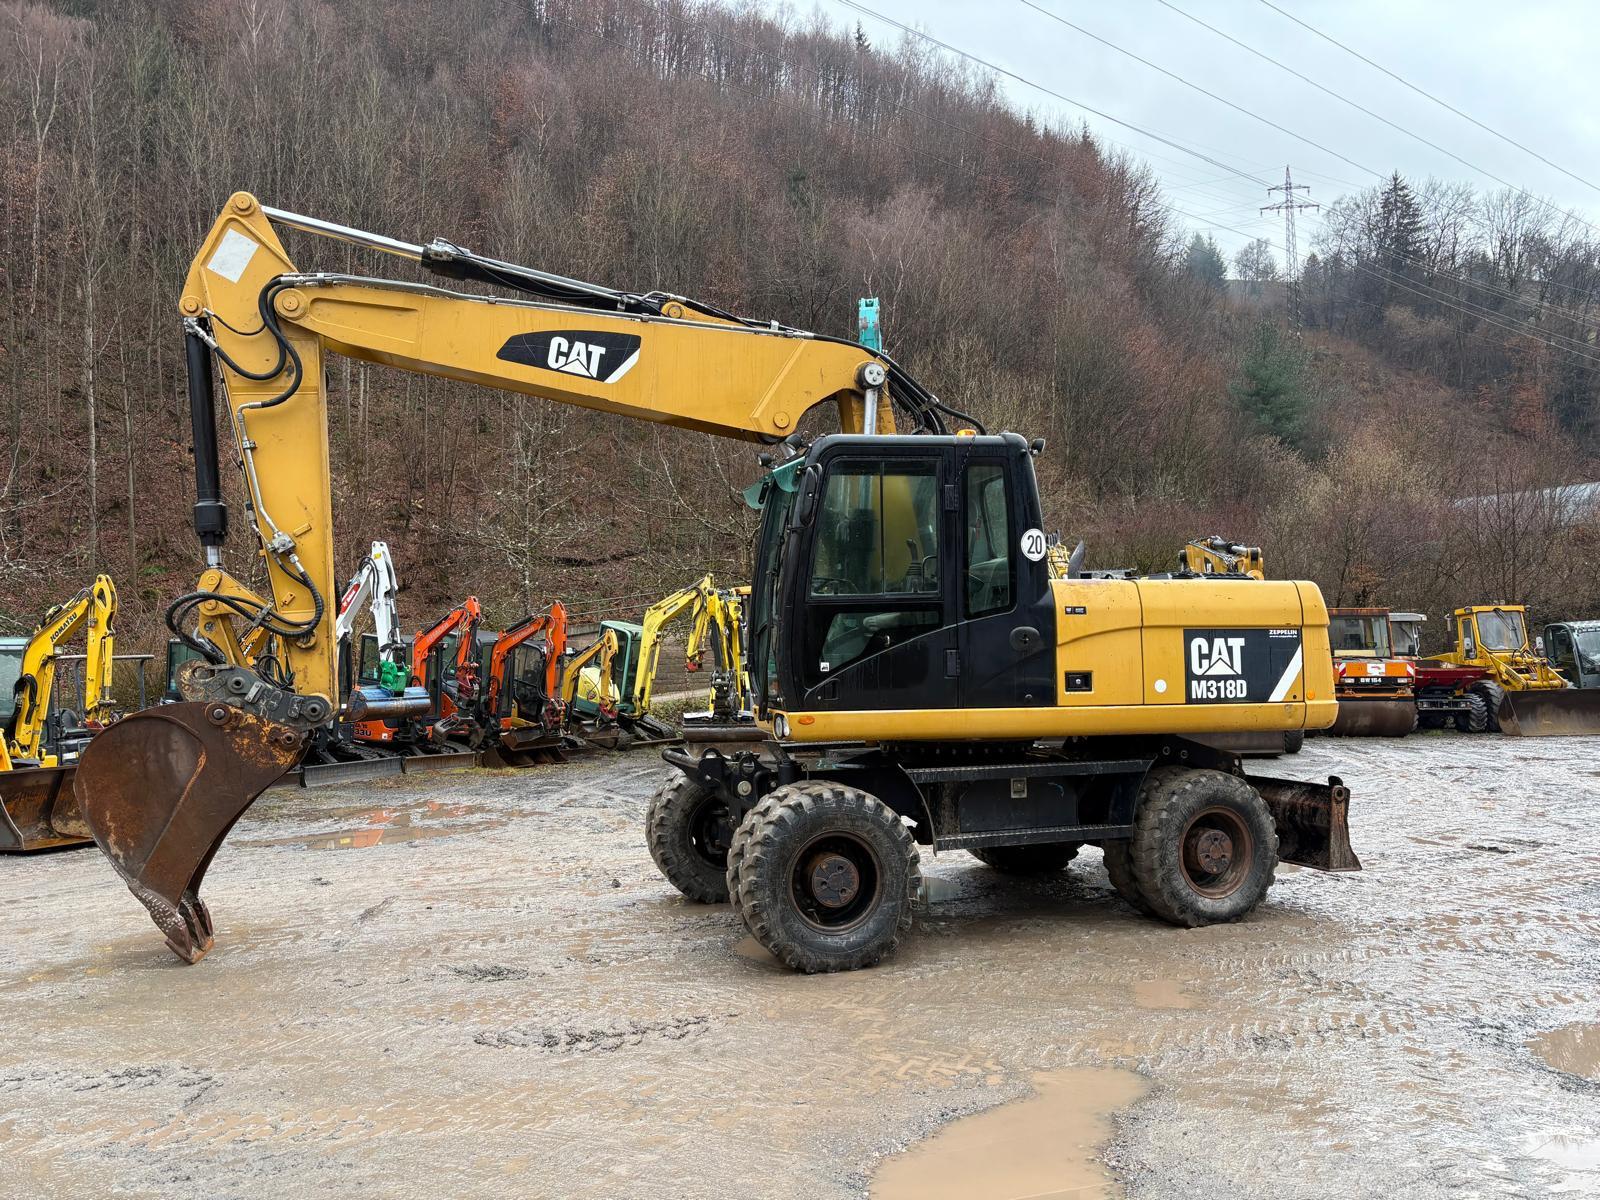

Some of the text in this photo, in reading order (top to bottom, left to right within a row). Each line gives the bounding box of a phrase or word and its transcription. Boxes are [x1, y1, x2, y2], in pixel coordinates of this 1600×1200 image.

[547, 336, 607, 378] CAT
[1026, 534, 1043, 555] 20
[50, 612, 78, 642] KOMATSU
[1190, 637, 1246, 676] CAT
[1191, 679, 1248, 699] M318D
